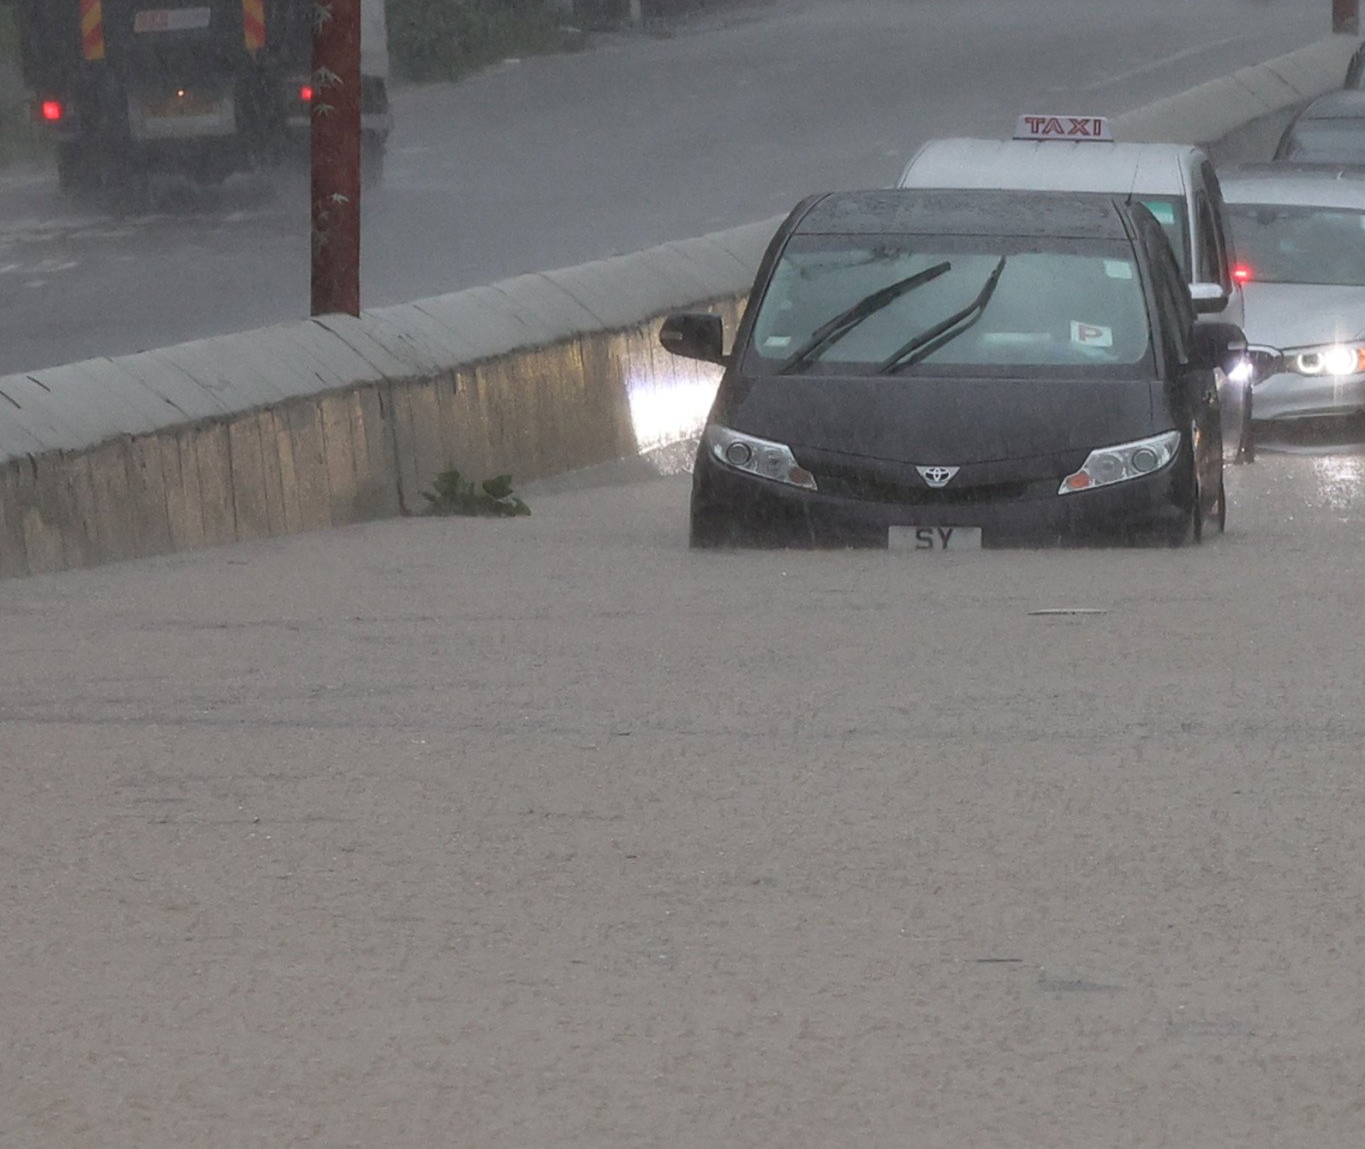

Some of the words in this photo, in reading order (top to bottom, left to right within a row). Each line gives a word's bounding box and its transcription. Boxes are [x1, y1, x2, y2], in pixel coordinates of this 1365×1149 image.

[1024, 116, 1102, 136] TAXI
[1077, 324, 1104, 342] P
[915, 526, 954, 550] SY
